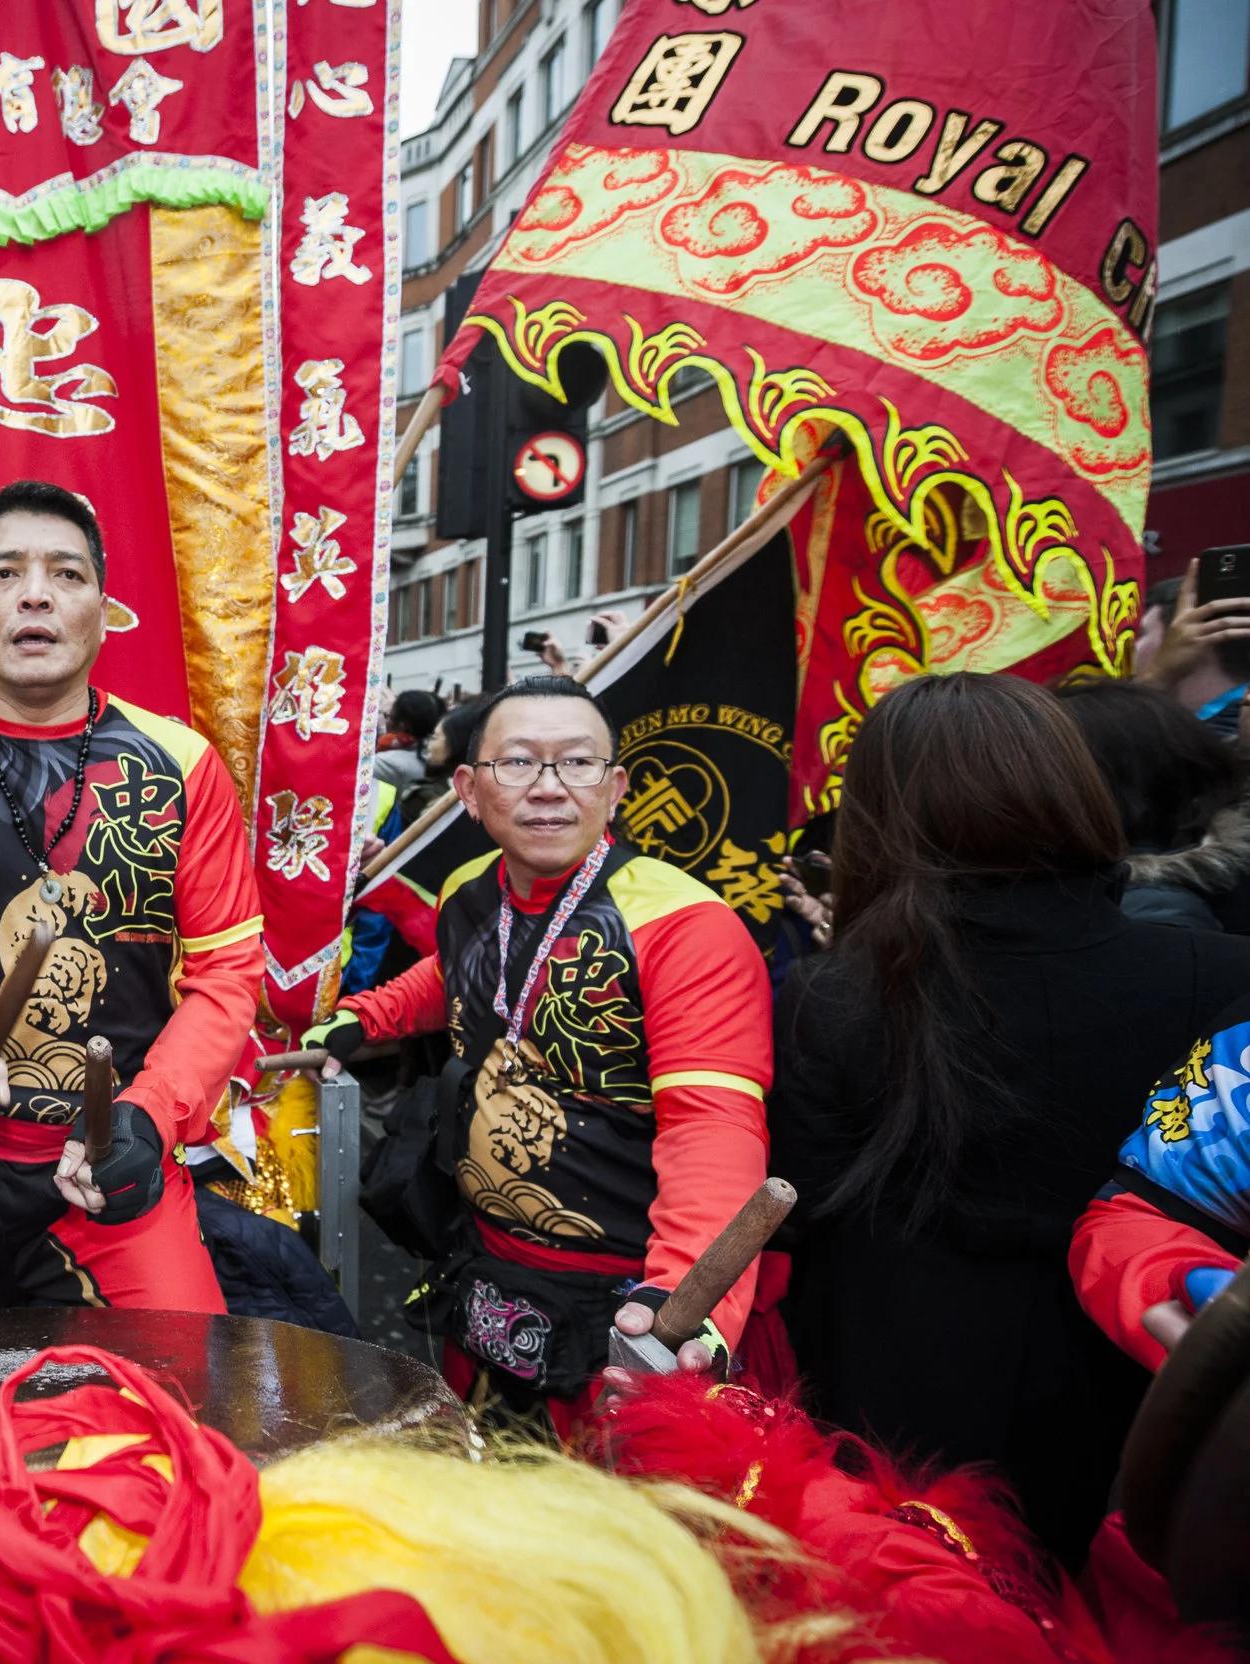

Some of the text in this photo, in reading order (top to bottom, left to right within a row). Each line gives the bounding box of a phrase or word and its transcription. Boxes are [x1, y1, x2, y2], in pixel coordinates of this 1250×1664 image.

[785, 69, 1091, 241] Royal
[667, 703, 711, 725] MO
[717, 703, 784, 744] WING
